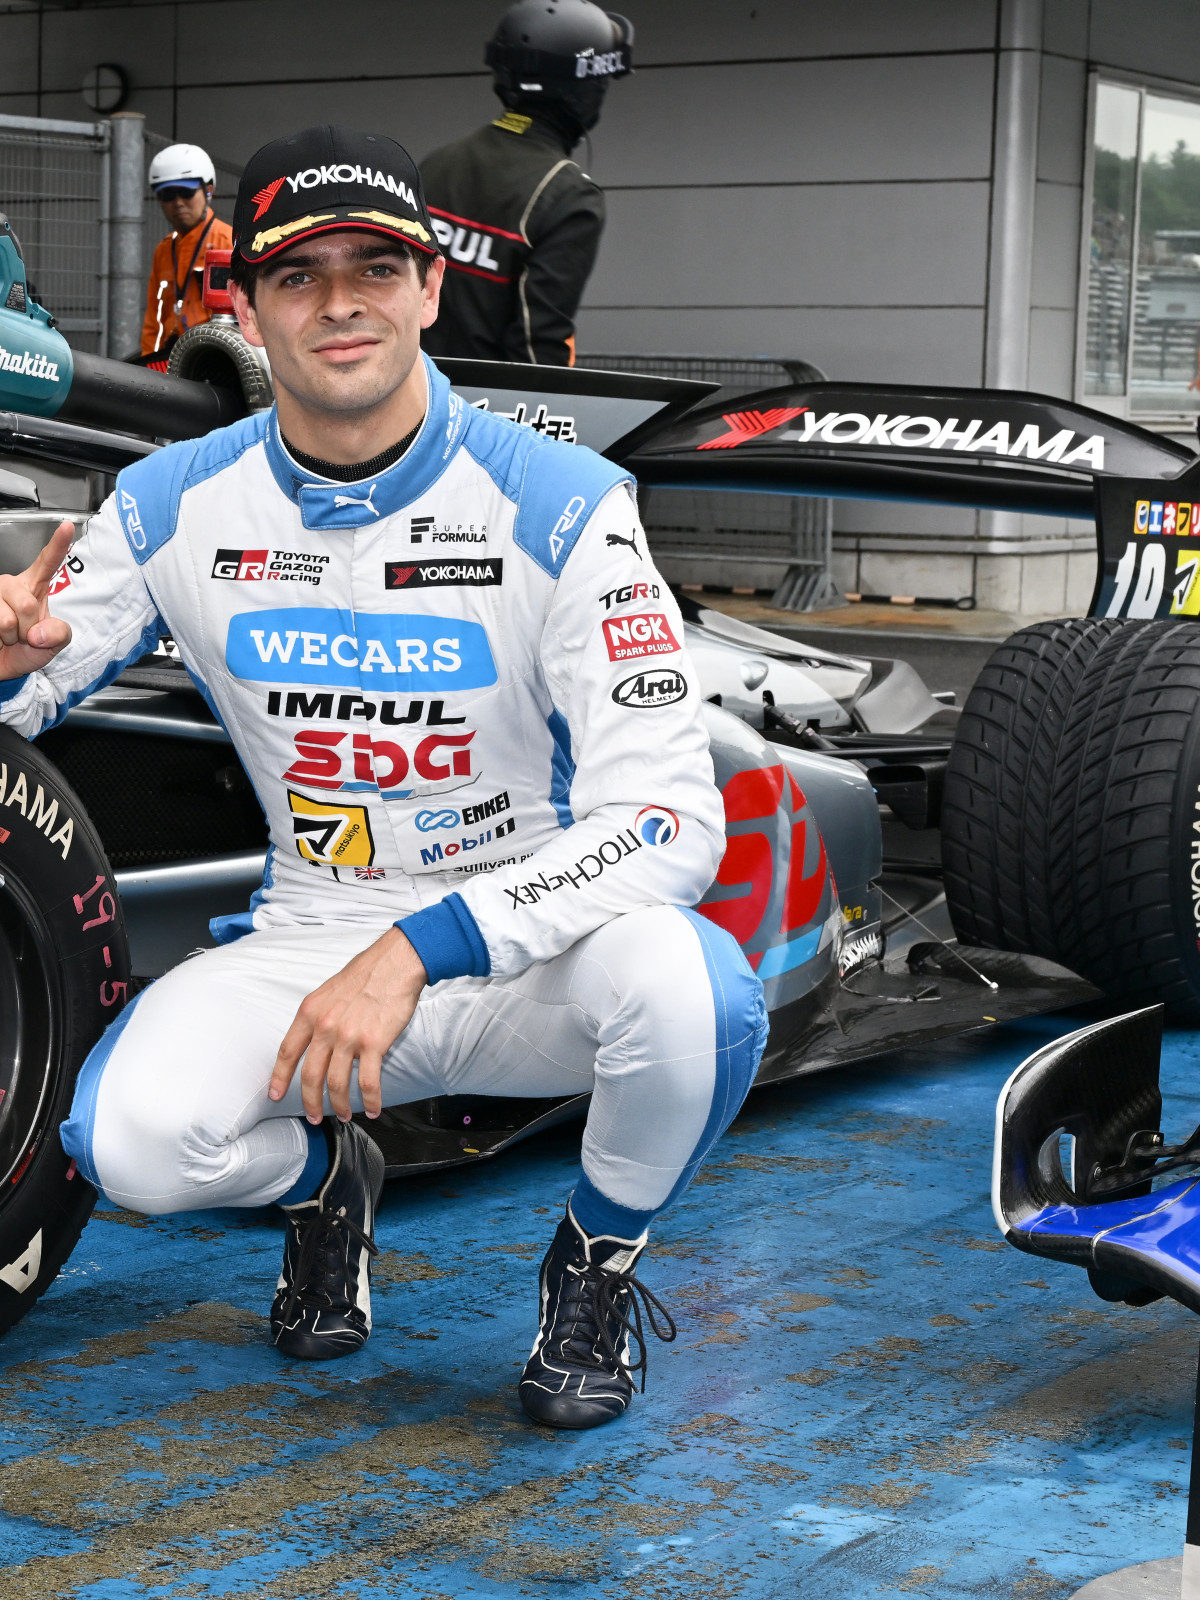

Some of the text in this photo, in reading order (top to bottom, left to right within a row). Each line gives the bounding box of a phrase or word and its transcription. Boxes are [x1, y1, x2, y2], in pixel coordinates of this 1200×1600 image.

[286, 164, 418, 212] YOKOHAMA
[799, 411, 1106, 470] YOKOHAMA
[432, 523, 488, 532] SUPER
[432, 532, 488, 543] FORMULA
[213, 561, 265, 580] GR
[269, 561, 324, 574] GAZOO
[272, 550, 330, 564] TOYOTA
[266, 571, 321, 586] Racing
[598, 583, 661, 611] TGR-D
[608, 617, 669, 647] NGK
[250, 629, 463, 674] WECARS
[615, 643, 674, 659] SPARK PLUGS
[620, 672, 684, 703] Arai
[267, 690, 467, 726] IMPUL
[461, 791, 512, 826] ENKEI
[334, 823, 361, 858] matsukiyo
[420, 830, 492, 866] Mobil
